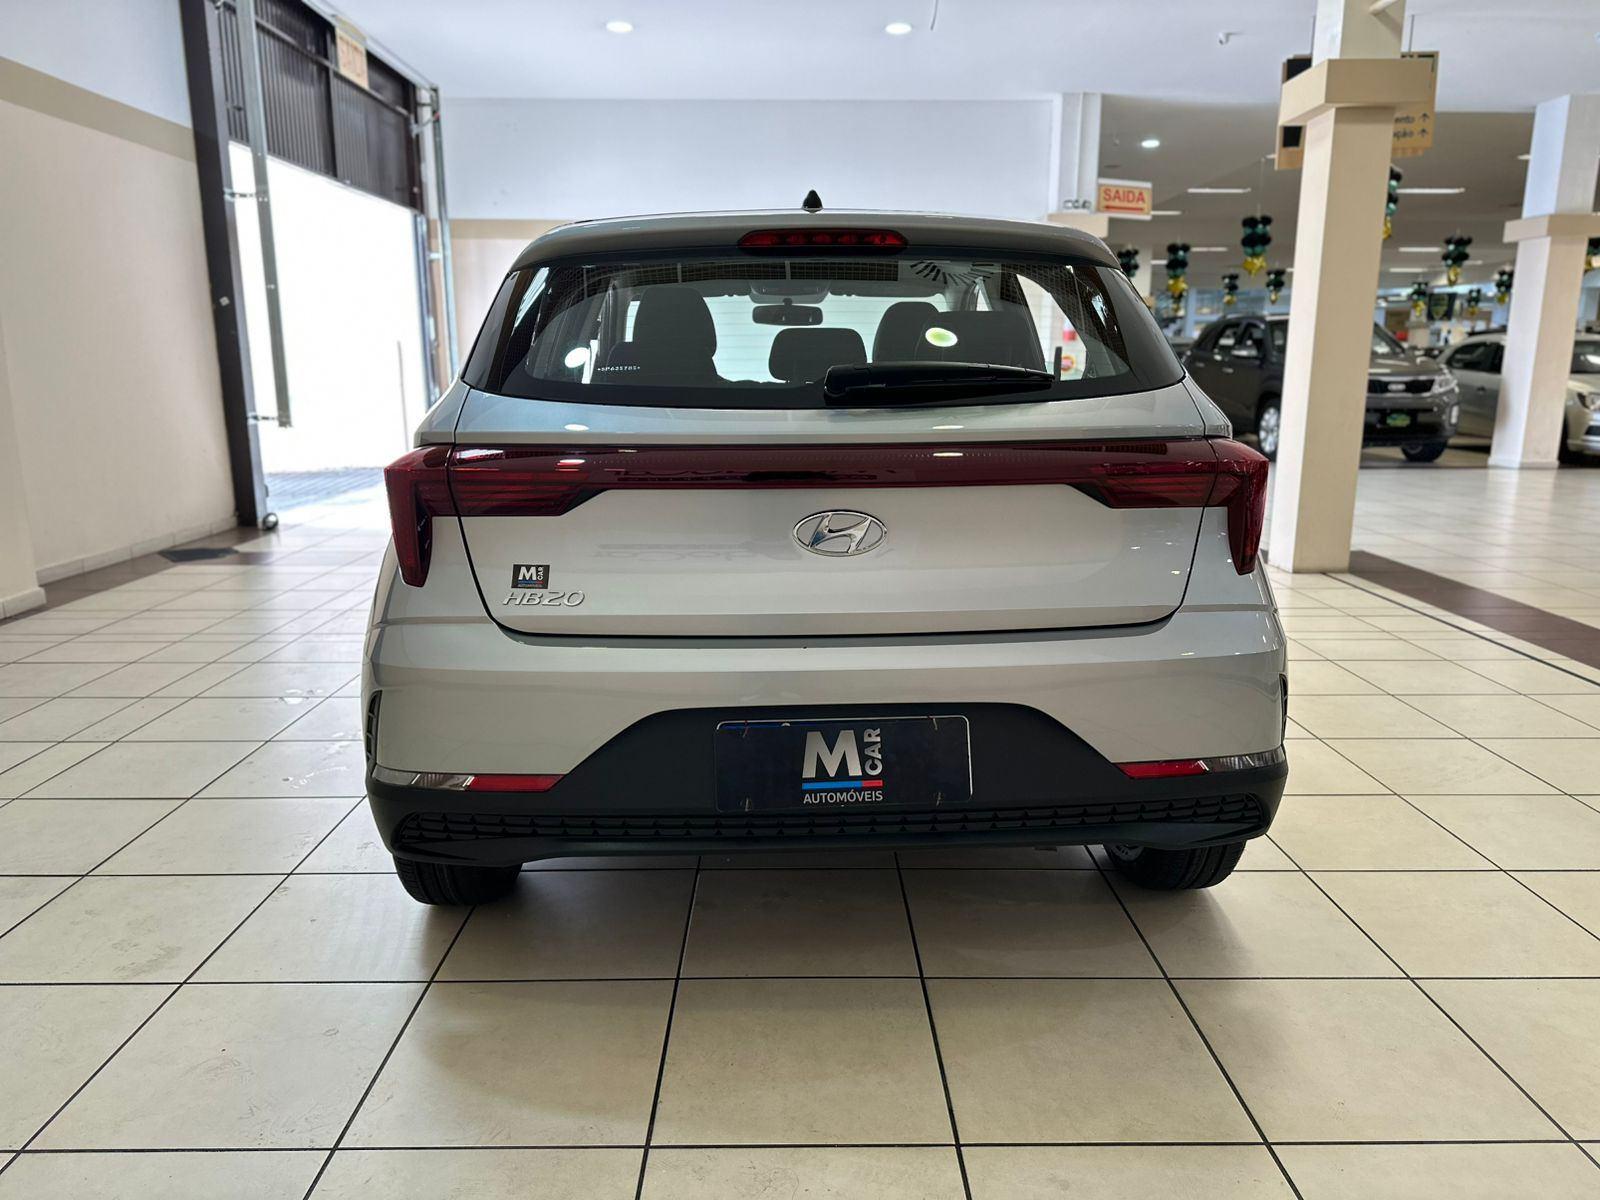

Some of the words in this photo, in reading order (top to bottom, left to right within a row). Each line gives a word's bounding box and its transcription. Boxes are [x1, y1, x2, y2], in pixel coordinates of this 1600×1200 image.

[518, 567, 536, 580] M
[502, 591, 585, 607] HB20
[802, 730, 862, 778] M
[864, 728, 882, 776] CAR
[803, 789, 883, 804] AUTOMÓVEIS
